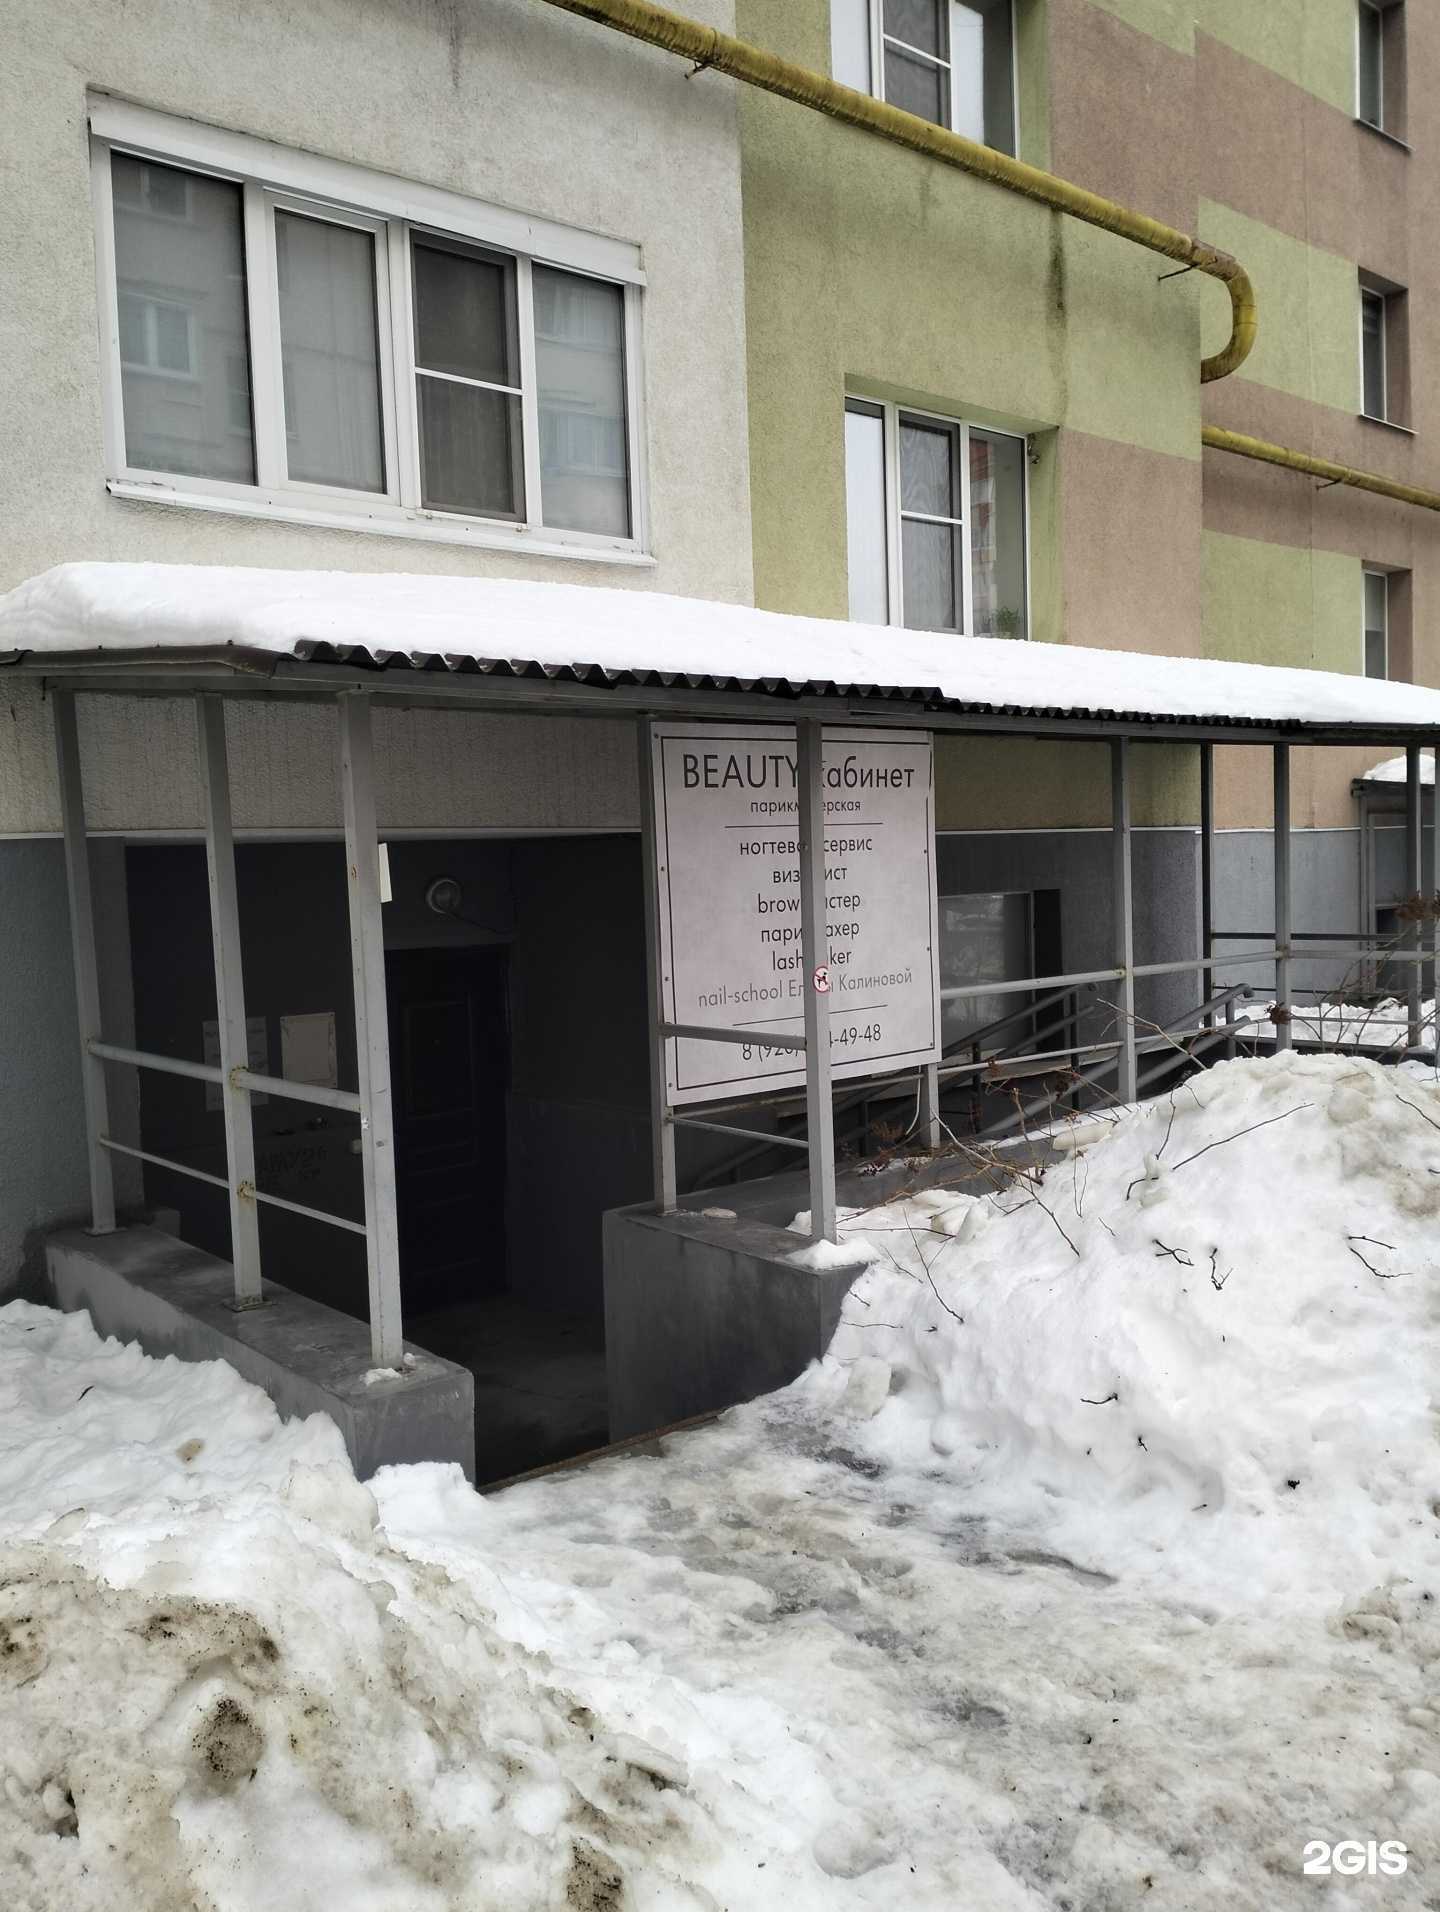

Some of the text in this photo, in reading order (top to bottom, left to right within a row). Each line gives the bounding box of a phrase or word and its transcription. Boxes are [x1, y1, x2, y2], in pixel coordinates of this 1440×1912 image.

[683, 754, 799, 789] BEAUTY
[751, 799, 862, 817] парикмрская
[740, 837, 873, 857] ногтев сервис
[773, 867, 848, 884] визист
[825, 894, 861, 911] стер
[761, 921, 860, 943] париахер
[772, 946, 852, 971] lashker
[698, 981, 783, 1008] nail-school
[839, 967, 913, 992] Калиновой
